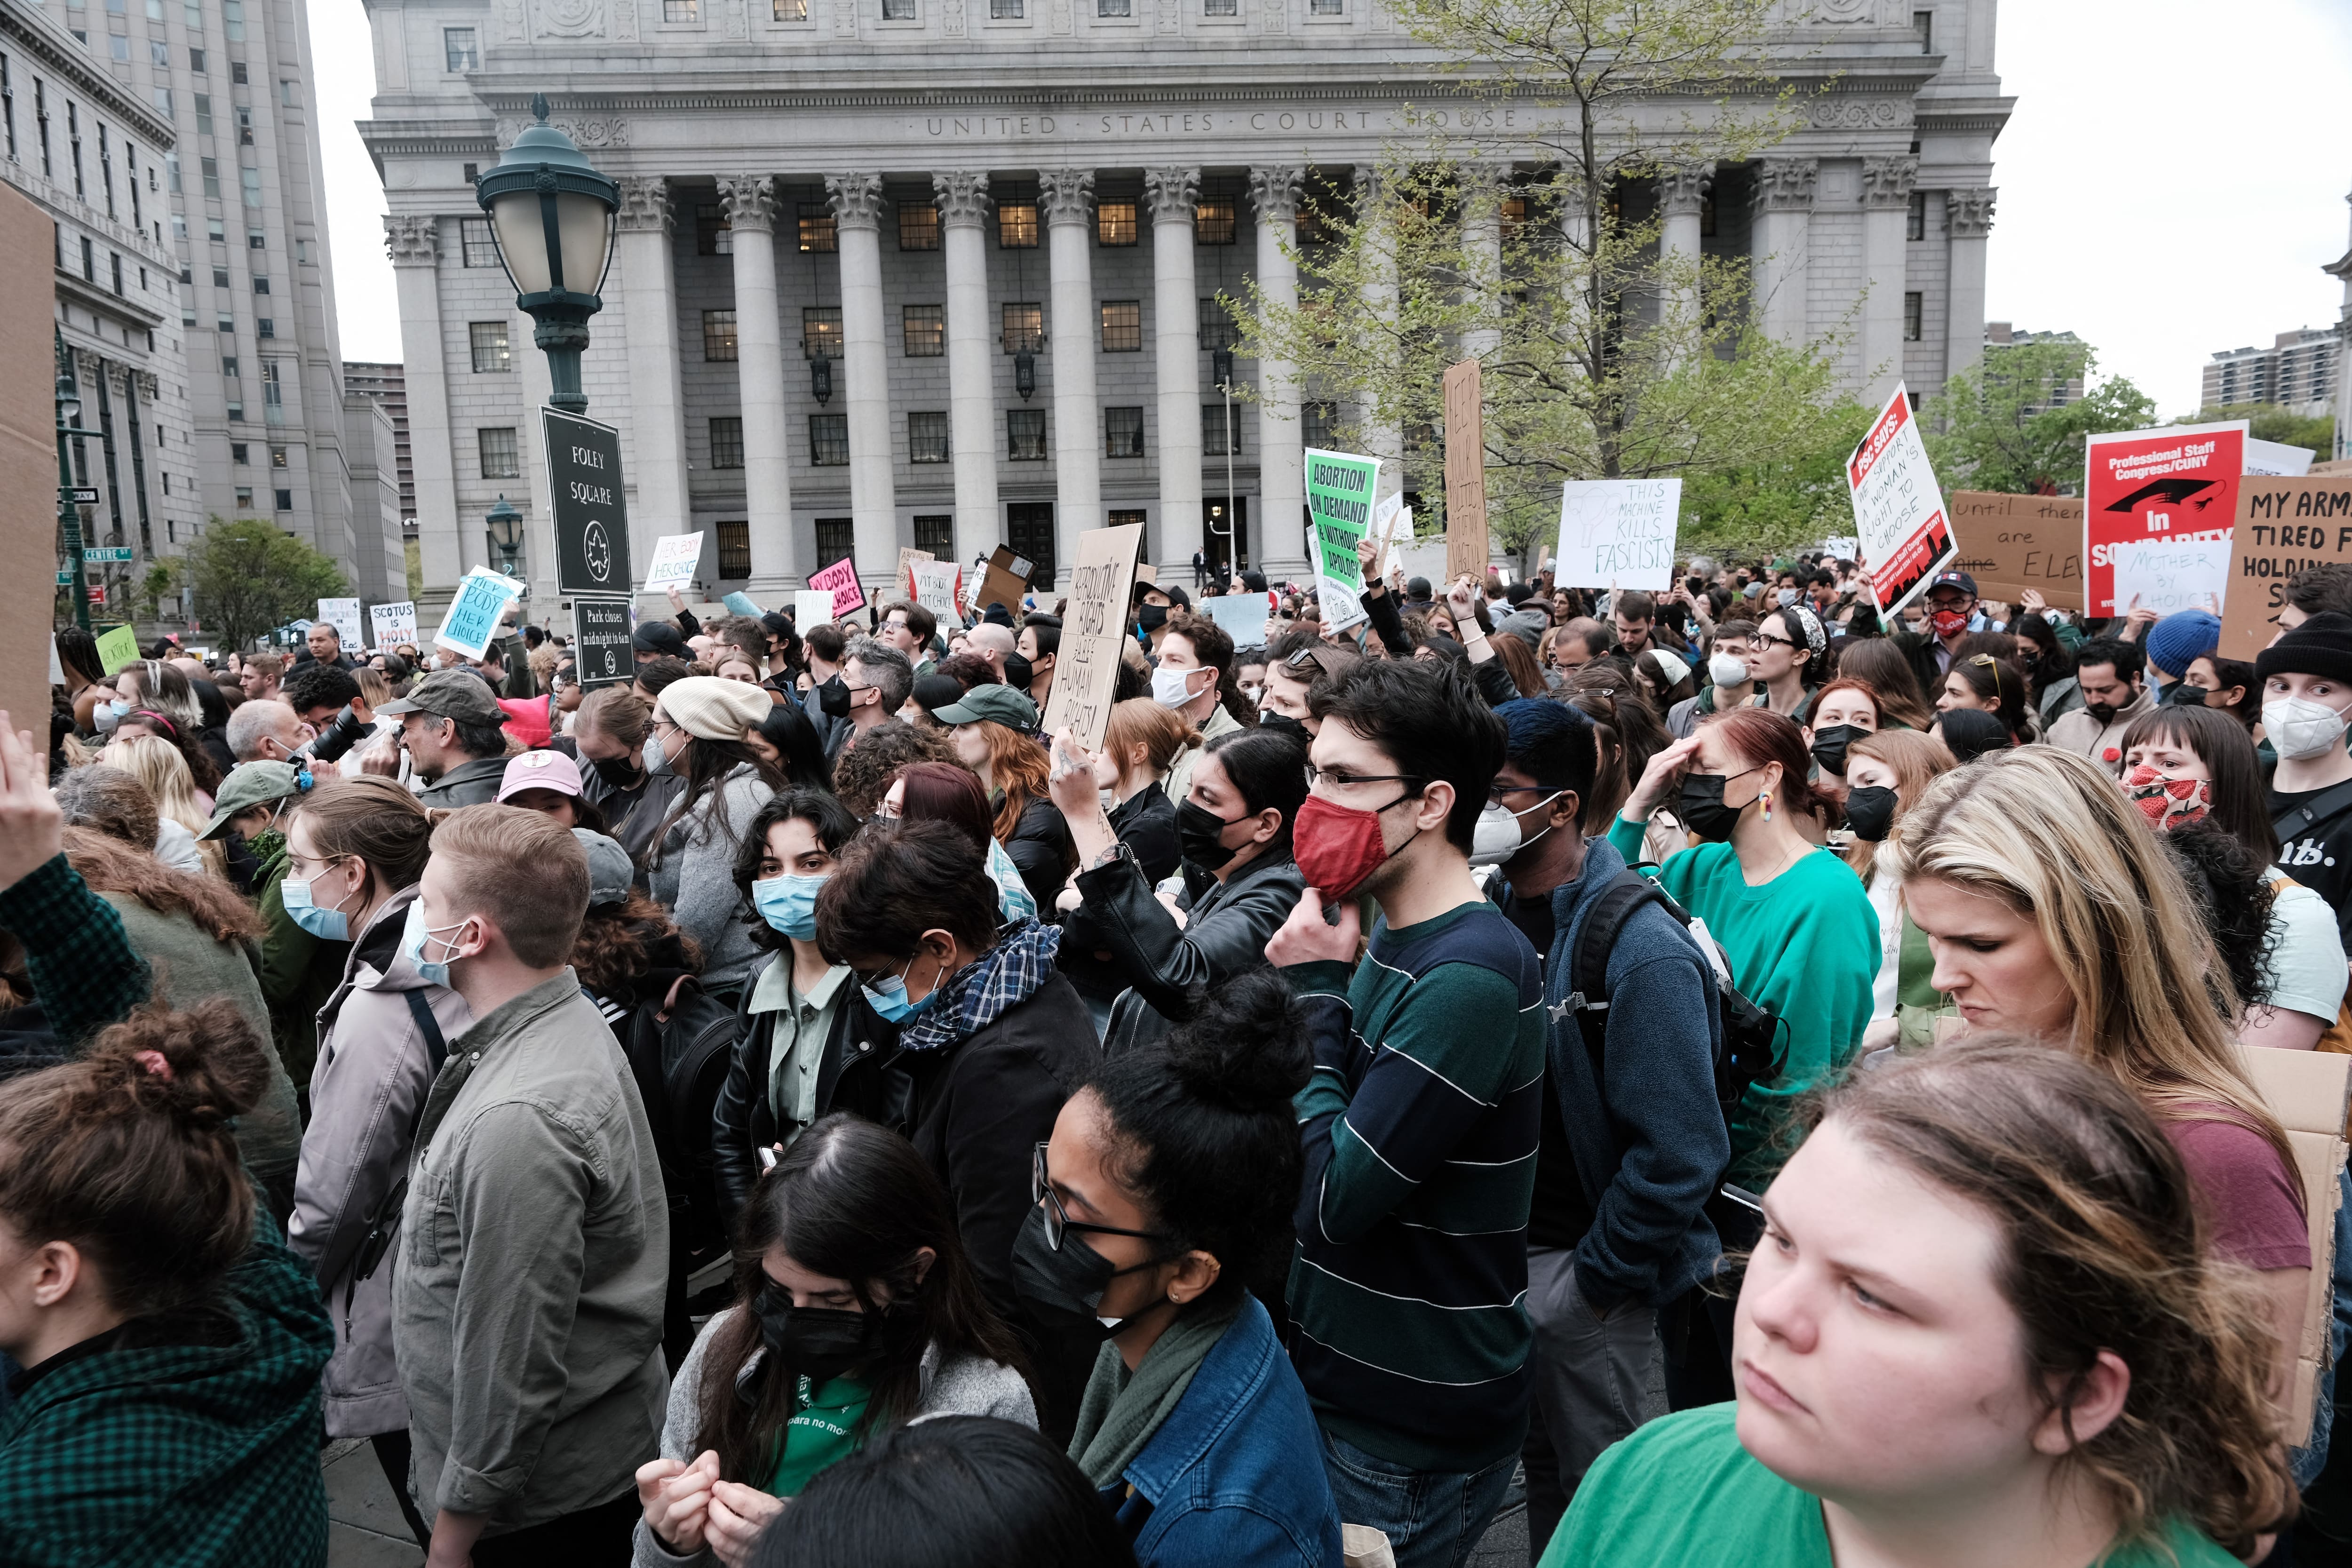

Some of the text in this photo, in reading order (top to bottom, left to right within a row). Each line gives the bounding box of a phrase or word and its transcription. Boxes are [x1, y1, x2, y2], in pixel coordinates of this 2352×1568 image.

[927, 110, 1515, 135] UNITED STATES COURT HOUSE
[1858, 413, 1898, 478] PSC SAYS:
[2109, 440, 2216, 470] Professional Staff
[572, 446, 604, 470] FOLEY
[1858, 427, 1908, 503] WE SUPPORT
[2115, 454, 2209, 481] Congress/CUNY
[1314, 463, 1366, 493] ABORTION
[1863, 446, 1919, 525] A WOMAN'S
[571, 481, 612, 505] SQUARE
[1626, 483, 1664, 500] THIS
[1311, 493, 1367, 524] ON DEMAND
[1378, 506, 1389, 522] END
[1619, 501, 1666, 517] MACHINE
[1866, 478, 1913, 544] RIGHT TO
[1956, 497, 2012, 516] until
[2250, 491, 2352, 518] MY ARM
[1615, 517, 1661, 541] KILLS
[1878, 496, 1919, 549] CHOOSE
[2146, 509, 2170, 532] In
[659, 537, 700, 559] HER BODY
[1319, 524, 1325, 541] &
[1324, 524, 1359, 552] WITHOUT
[1998, 532, 2034, 543] are
[2251, 525, 2325, 549] TIRED
[85, 549, 118, 560] CENTRE
[1327, 550, 1359, 581] APOLOGY
[1596, 535, 1673, 573] FASCISTS
[1952, 556, 2000, 572] nine
[2129, 551, 2216, 573] MOTHER
[655, 559, 697, 579] HER CHOICE
[824, 565, 851, 591] BODY
[1073, 557, 1120, 603] REPRODUCTIVE
[474, 577, 501, 592] HER
[920, 575, 947, 589] MY BODY
[2156, 574, 2176, 589] BY
[463, 587, 502, 614] BODY
[796, 594, 832, 610] MY BODY
[833, 586, 859, 610] HOICE
[919, 594, 952, 609] MY CHOICE
[2139, 591, 2217, 608] CHOICE
[374, 605, 413, 618] SCOTUS
[391, 619, 399, 628] IS
[457, 608, 486, 629] HER
[587, 610, 622, 623] Park closes
[1077, 600, 1104, 636] RIGHTS
[378, 628, 413, 643] HOLY
[447, 619, 487, 644] CHOICE!
[583, 631, 629, 648] midnight to 6am
[1077, 638, 1091, 661] ARE
[1059, 661, 1093, 700] HUMAN
[1062, 699, 1097, 744] RIGHTS!
[787, 1417, 810, 1426] para
[812, 1418, 825, 1428] no
